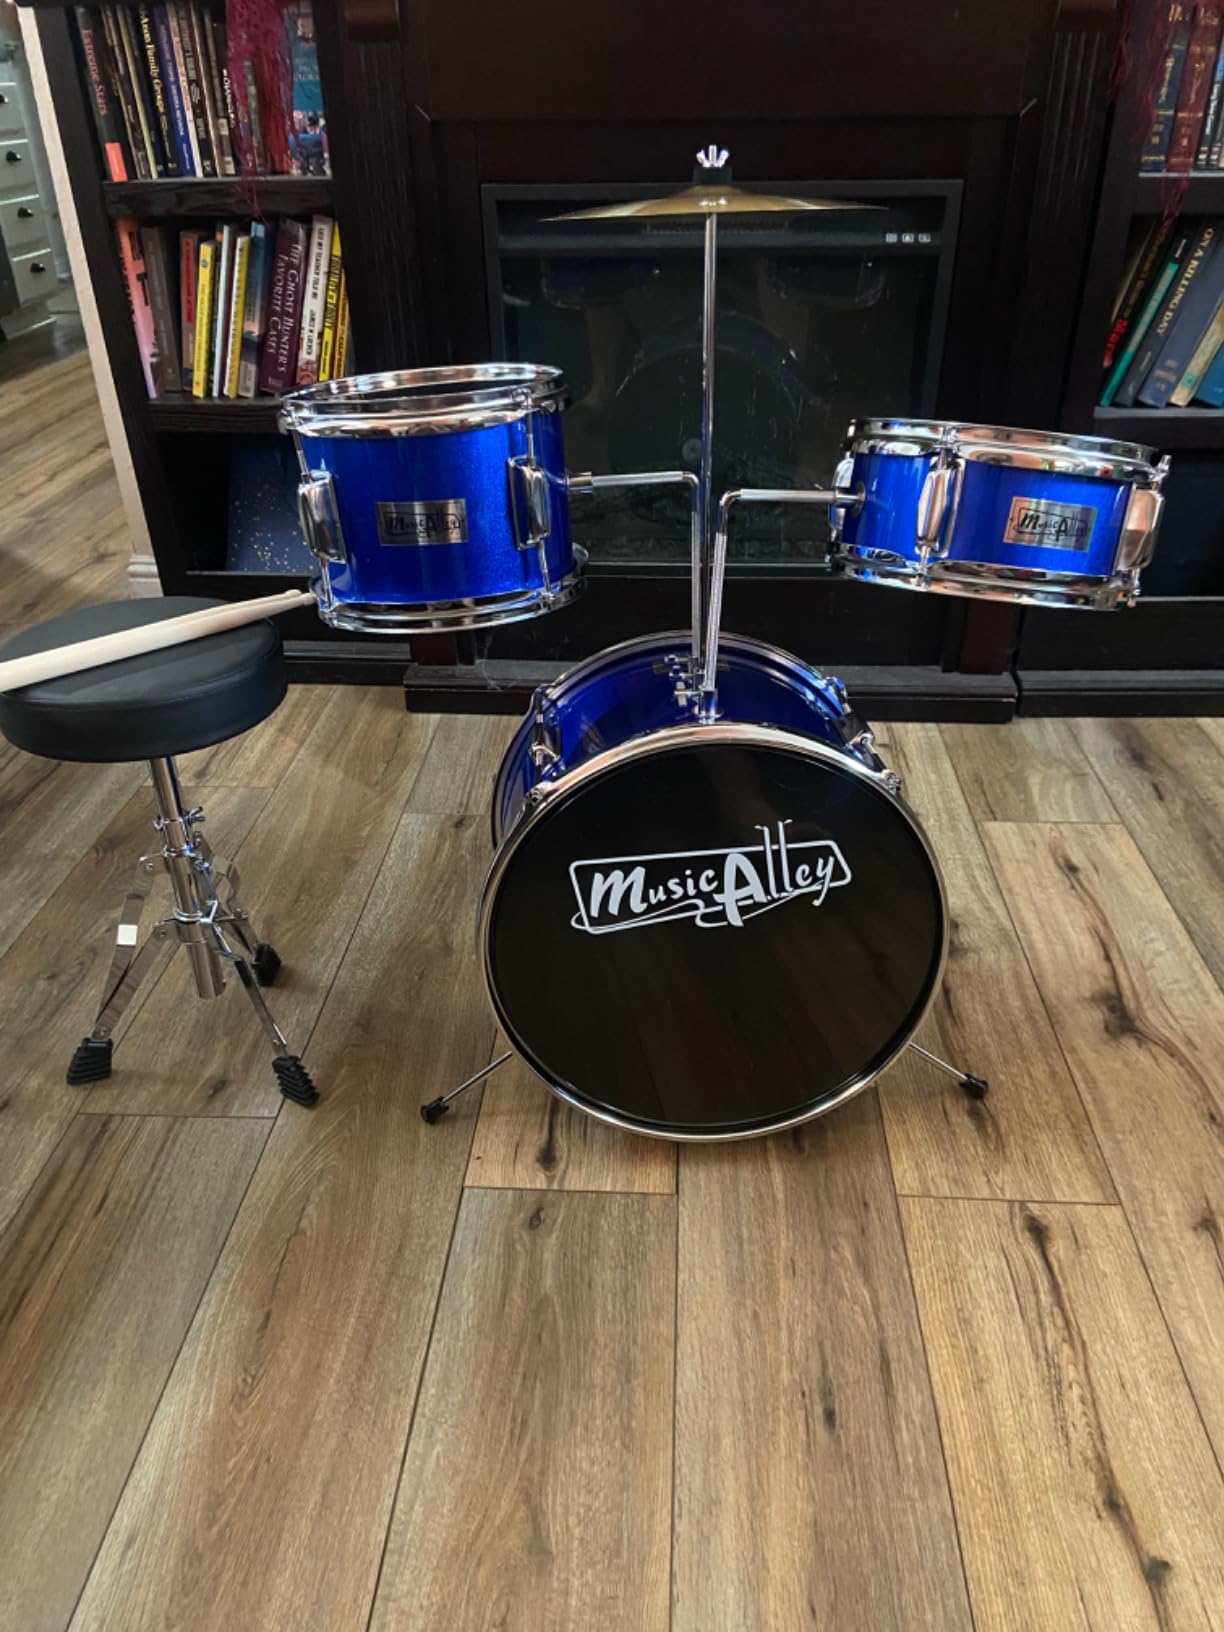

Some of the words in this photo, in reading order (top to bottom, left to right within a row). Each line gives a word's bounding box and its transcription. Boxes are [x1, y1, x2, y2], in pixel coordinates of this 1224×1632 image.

[1193, 247, 1205, 259] A
[1198, 226, 1215, 248] ON
[271, 253, 288, 312] FAVORITE
[283, 268, 298, 313] GHOST
[1167, 258, 1199, 310] KILLING
[266, 316, 281, 353] CASES
[1154, 309, 1174, 337] DAY
